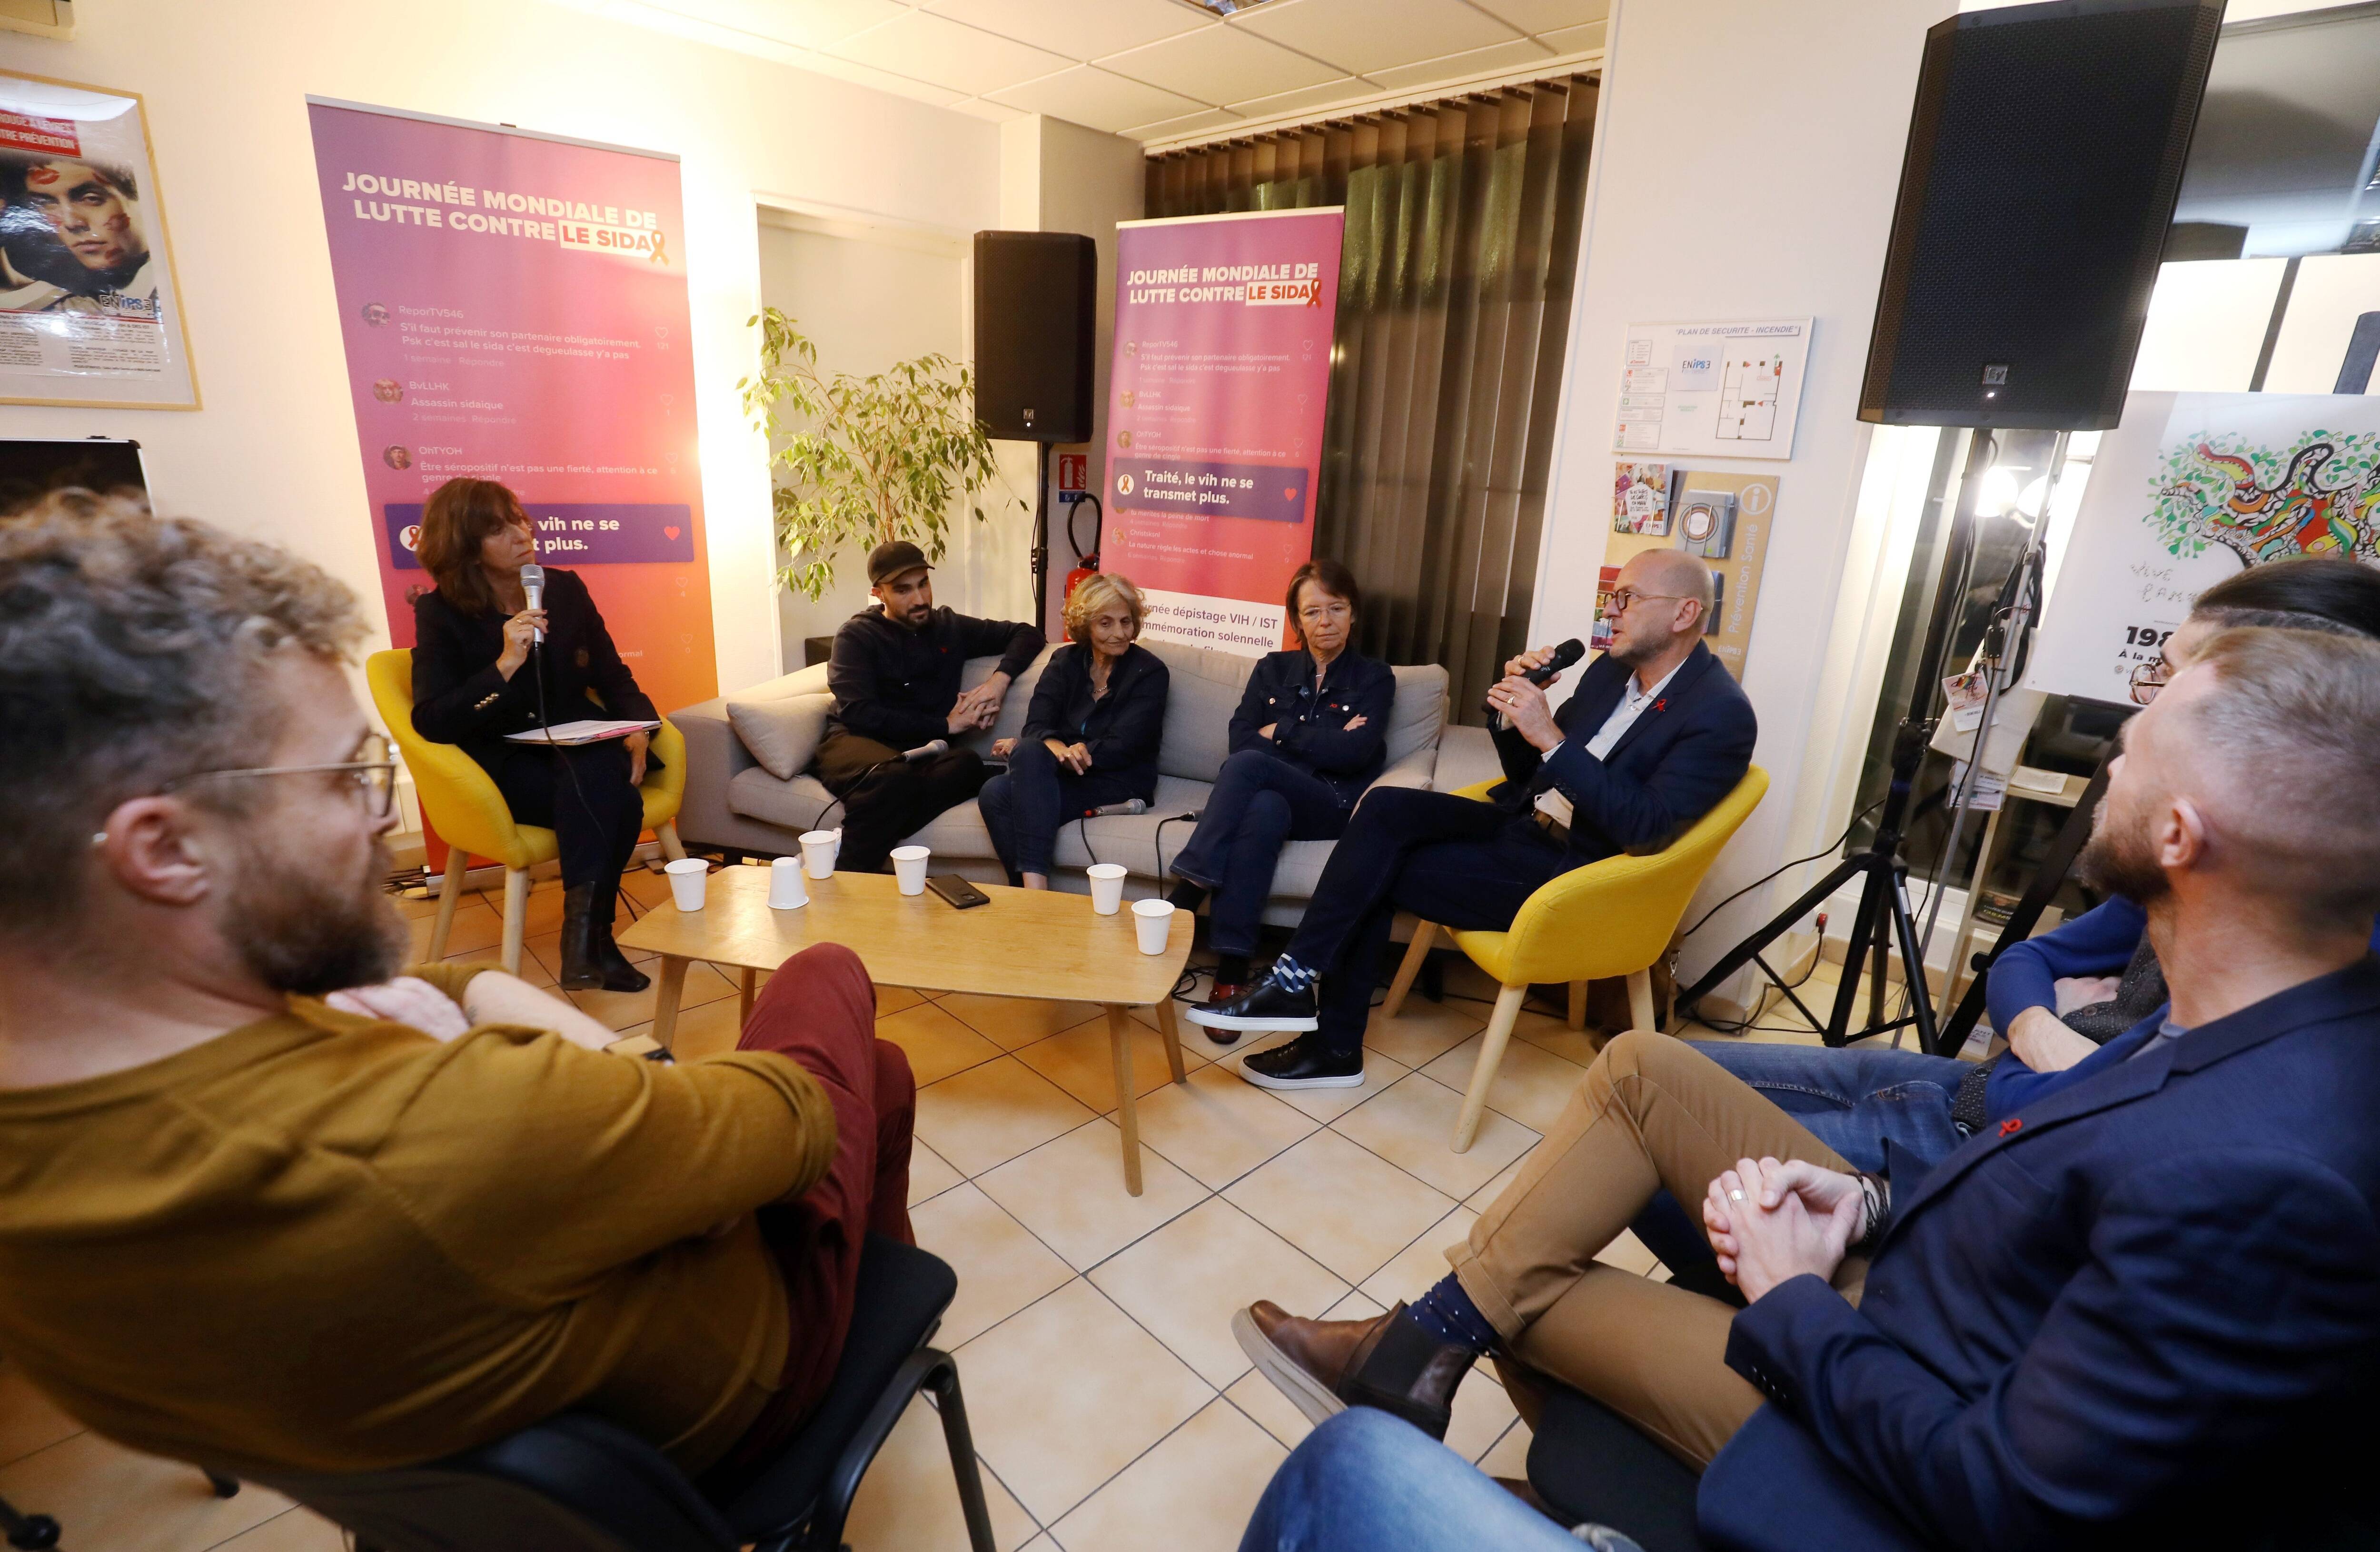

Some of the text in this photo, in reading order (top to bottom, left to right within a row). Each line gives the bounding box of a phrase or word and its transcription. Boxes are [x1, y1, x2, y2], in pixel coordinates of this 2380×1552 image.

[342, 172, 657, 230] JOURNÉE MONDIALE DE
[354, 199, 652, 252] LUTTE CONTRE LE SIDA
[1126, 262, 1319, 286] JOURNÉE MONDIALE DE
[1129, 283, 1310, 304] LUTTE CONTRE LE SIDA
[398, 305, 464, 319] ReporTV546
[419, 323, 441, 334] faut
[444, 326, 487, 337] prévenir
[511, 331, 562, 342] partenaire
[564, 335, 641, 348] obligatoirement.
[1142, 340, 1179, 348] ReporTV546
[402, 335, 422, 346] Psk
[453, 340, 468, 348] sal
[470, 340, 480, 349] le
[482, 341, 504, 351] sida
[533, 345, 594, 357] degueulasse
[613, 351, 630, 360] pas
[1215, 364, 1256, 373] degueulasse
[409, 381, 450, 391] BvLLHK
[411, 398, 458, 408] Assassin
[418, 446, 462, 455] OhTYOH
[1242, 448, 1271, 457] attention
[420, 461, 442, 471] Être
[444, 463, 498, 473] séropositif
[500, 464, 525, 472] n'est
[526, 466, 545, 474] pas
[566, 465, 594, 474] fierté,
[596, 465, 637, 474] attention
[639, 466, 645, 474] à
[421, 475, 453, 483] genre
[1145, 469, 1254, 489] Traité, le vih ne se
[1143, 487, 1230, 505] transmet plus.
[537, 516, 566, 531] vih
[571, 519, 595, 531] ne
[598, 519, 620, 531] se
[544, 537, 589, 554] plus.
[1728, 523, 1758, 633] Prévention Santé
[1173, 606, 1227, 624] dépistage
[1230, 613, 1250, 626] VIH
[1252, 616, 1258, 627] /
[1259, 617, 1279, 629] IST
[1142, 621, 1215, 639] mmémoration
[1218, 631, 1274, 648] solennelle
[2126, 626, 2174, 647] 198
[618, 650, 643, 658] ormal
[2132, 652, 2144, 661] la
